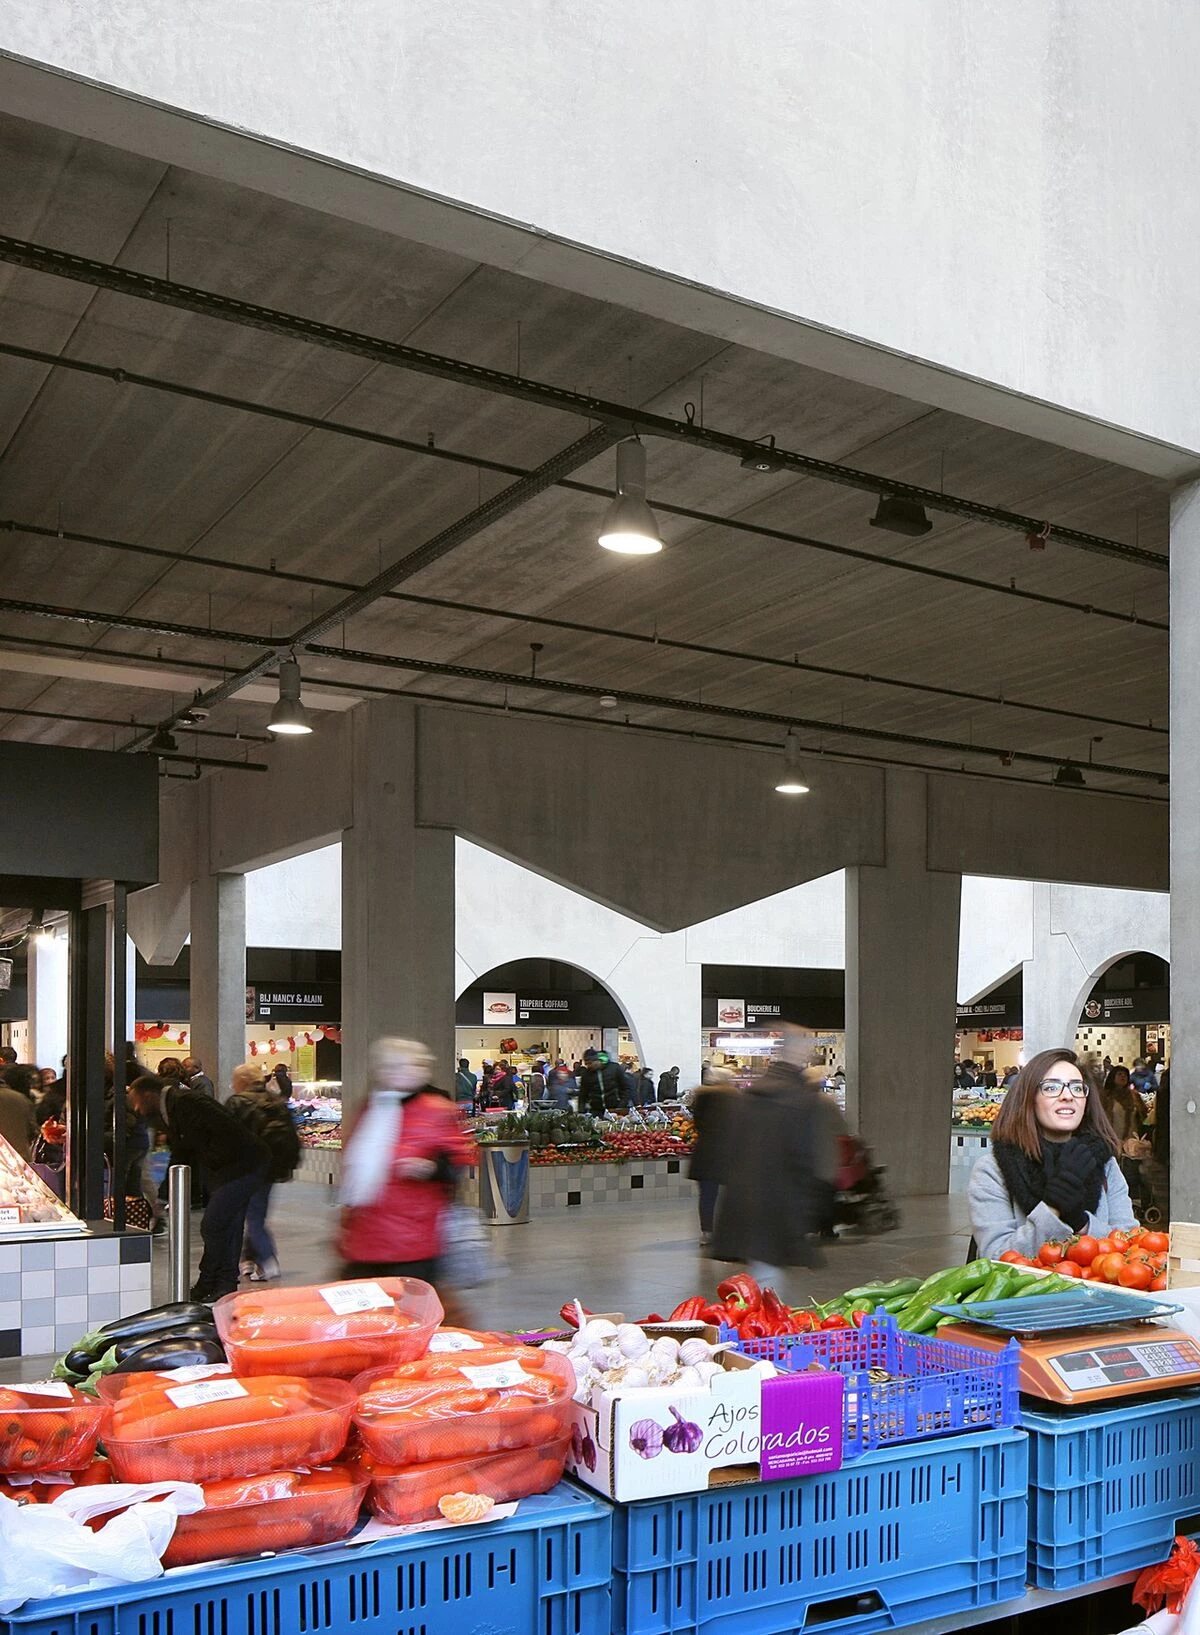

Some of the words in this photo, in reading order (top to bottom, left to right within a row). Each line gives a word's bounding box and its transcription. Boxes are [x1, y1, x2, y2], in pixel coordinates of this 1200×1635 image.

[260, 993, 271, 1003] BIJ
[272, 993, 295, 1003] NANCY
[296, 994, 302, 1003] &
[303, 994, 322, 1004] ALAIN
[520, 999, 543, 1008] TRIPERIE
[708, 1403, 759, 1433] Ajos
[705, 1422, 830, 1458] Colorados
